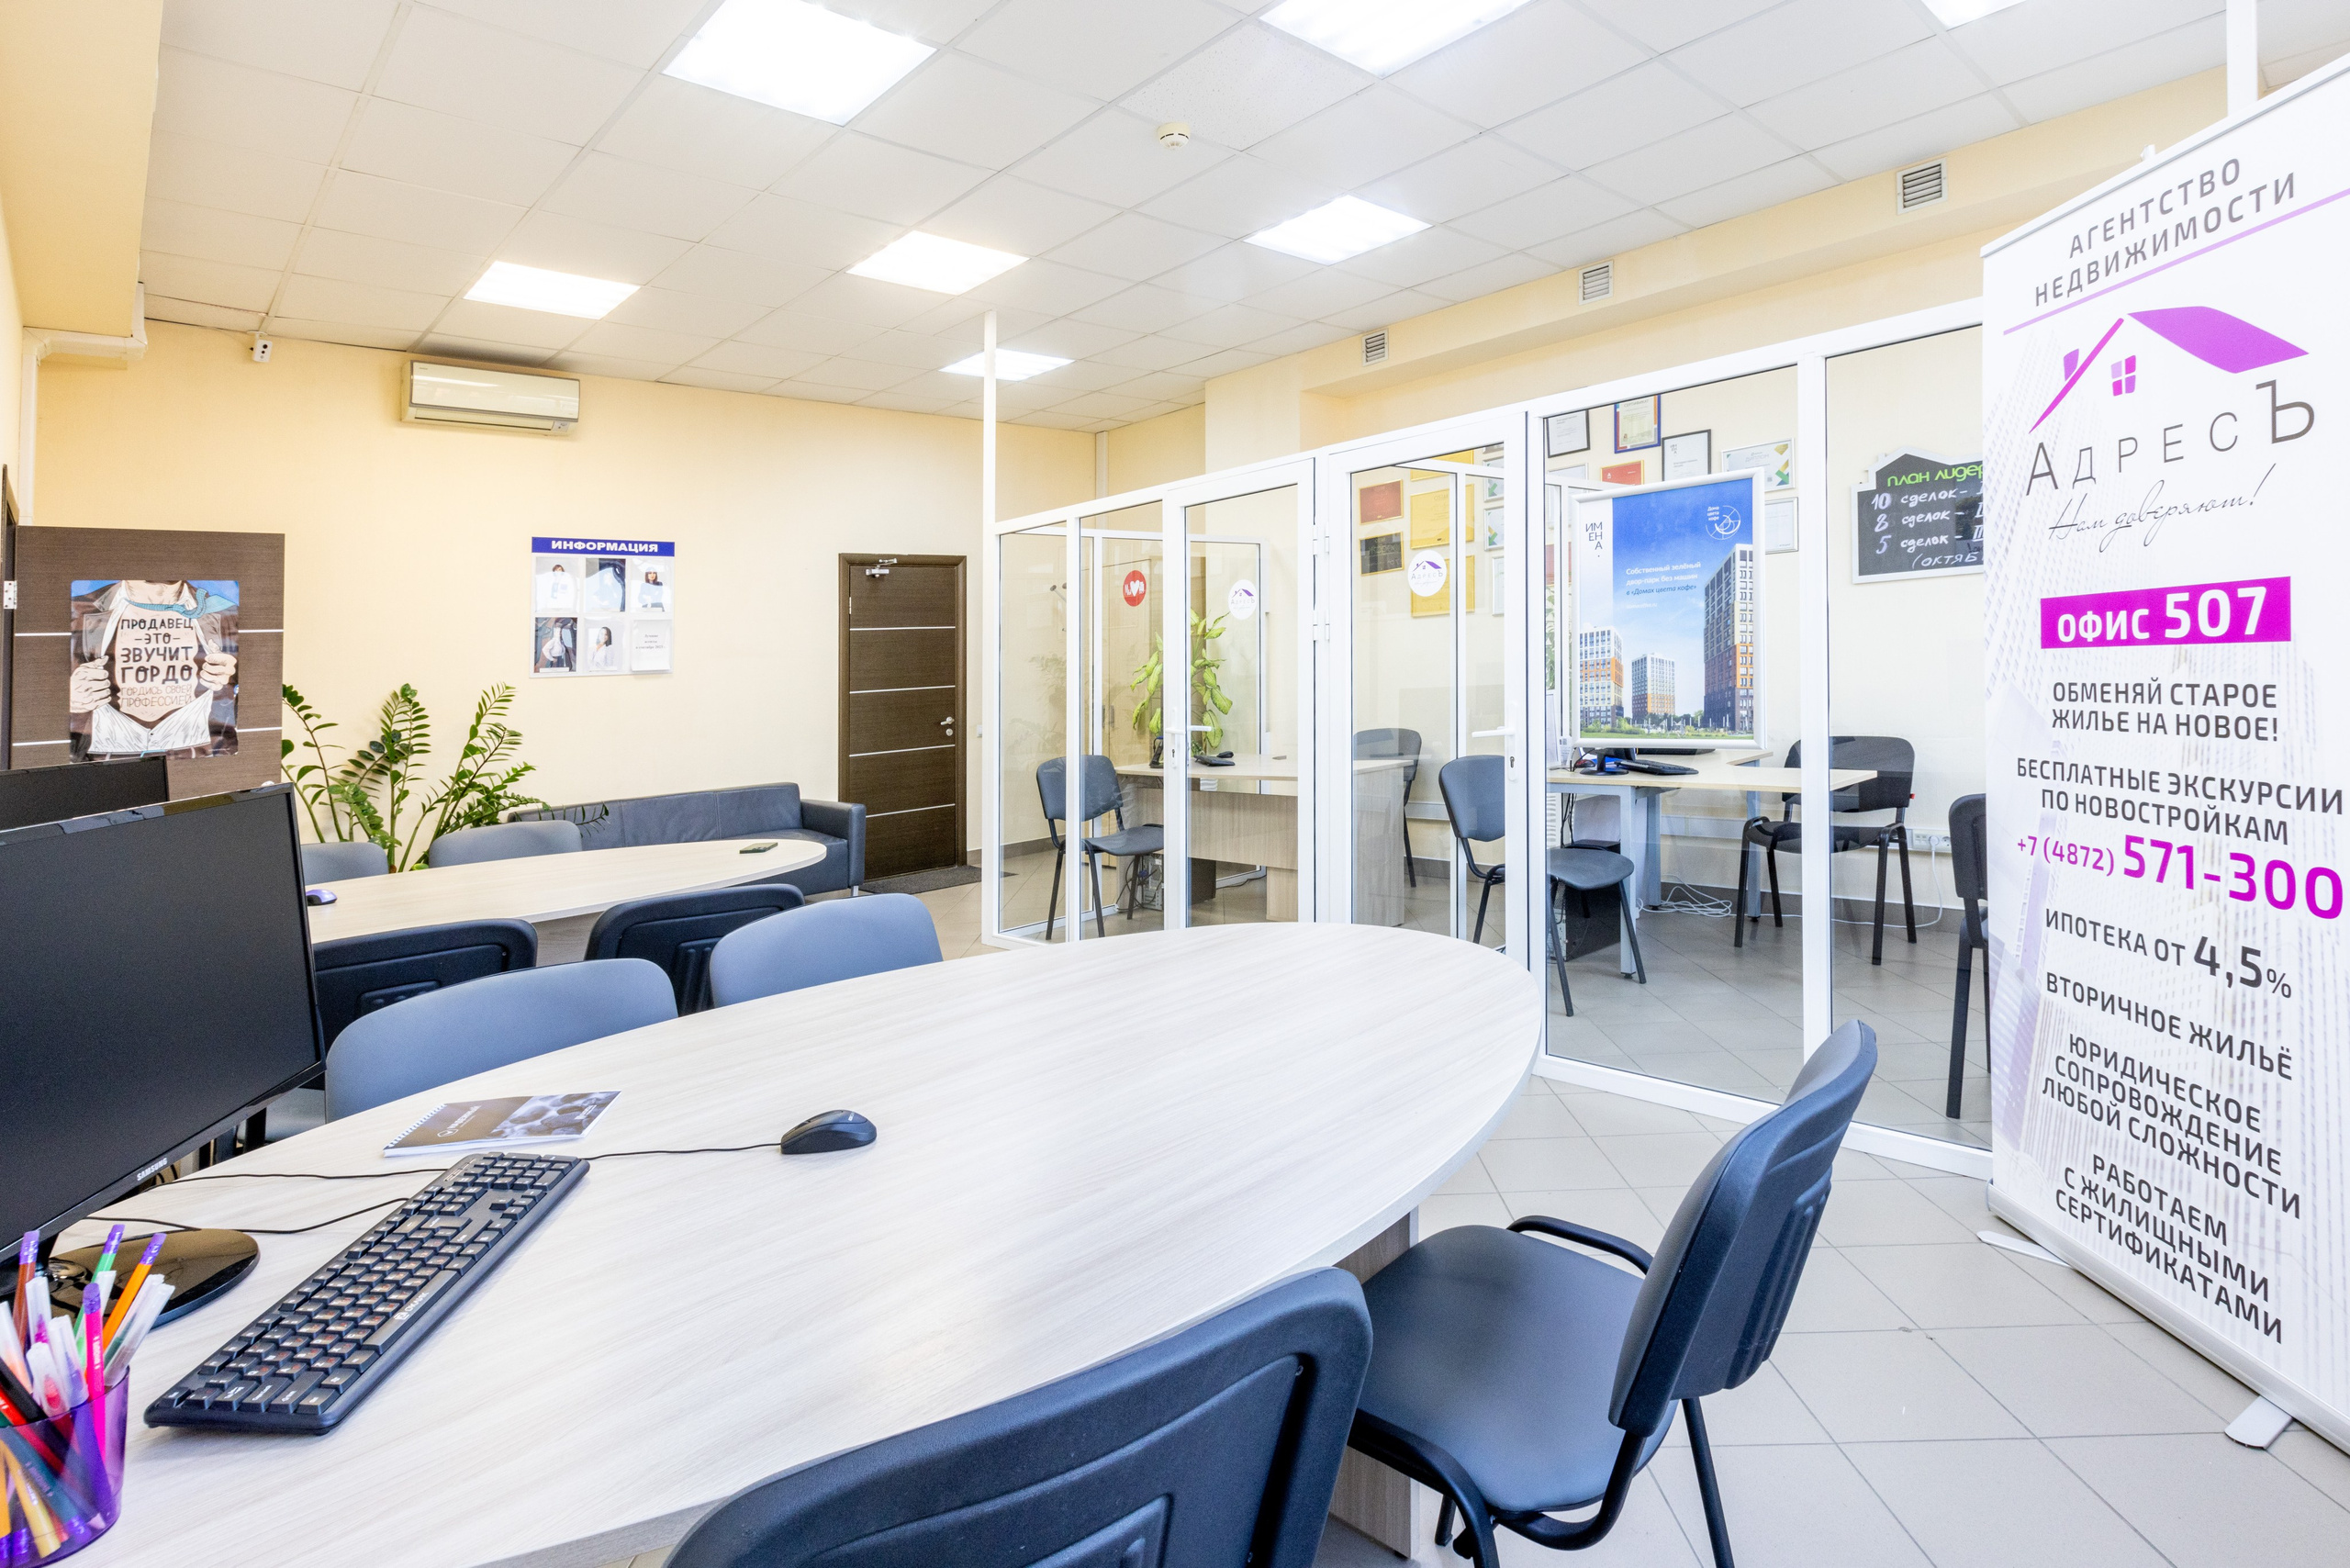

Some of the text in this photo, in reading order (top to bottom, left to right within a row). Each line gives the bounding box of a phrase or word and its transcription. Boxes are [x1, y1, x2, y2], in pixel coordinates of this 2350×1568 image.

[2069, 158, 2240, 259] АГЕНТСТВО
[2035, 172, 2295, 308] НЕДВИЖИМОСТИ
[1871, 492, 1892, 510] 10
[1874, 513, 1889, 532] 8
[1901, 510, 1951, 529] сделок
[551, 540, 658, 554] ИНФОРМАЦИЯ
[1875, 534, 1892, 554] 5
[1900, 535, 1949, 554] сделок
[1911, 552, 1984, 569] (ОКТЯБ
[1626, 562, 1701, 575] Собственный зелёный
[1626, 577, 1660, 587] двор-парк
[120, 618, 194, 631] ПРОДАВЕЦ
[2056, 586, 2268, 644] ОФИС 507
[120, 646, 193, 663] ЗВУЧИТ
[120, 664, 193, 684] ГОРДО
[120, 683, 192, 697] ГОРДИСЬ СВОЕЙ
[120, 694, 192, 708] ПРОФЕССИЕЙ
[2052, 677, 2278, 709] ОБМЕНЯЙ СТАРОЕ
[2051, 709, 2279, 742] ЖИЛЬЕ НА НОВОЕ!
[2017, 757, 2344, 815] БЕСПЛАТНЫЕ ЭКСКУРСИИ
[2042, 789, 2288, 846] ПО НОВОСТРОЙКАМ
[2017, 834, 2344, 920] +7 (4872) 571-300
[2045, 908, 2147, 957] ИПОТЕКА
[2154, 938, 2186, 967] ОТ
[2046, 971, 2293, 1081] ВТОРИЧНОЕ ЖИЛЬЁ
[2069, 1033, 2262, 1134] ЮРИДИЧЕСКОЕ
[2054, 1055, 2282, 1177] СОПРОВОЖДЕНИЕ
[2042, 1077, 2300, 1220] ЛЮБОЙ СЛОЖНОСТИ
[137, 1157, 168, 1181] SAMSUNG
[2093, 1154, 2228, 1247] РАБОТАЕМ
[2065, 1167, 2270, 1304] С ЖИЛИЩНЫМИ
[2055, 1190, 2283, 1345] СЕРТИФИКАТАМИ
